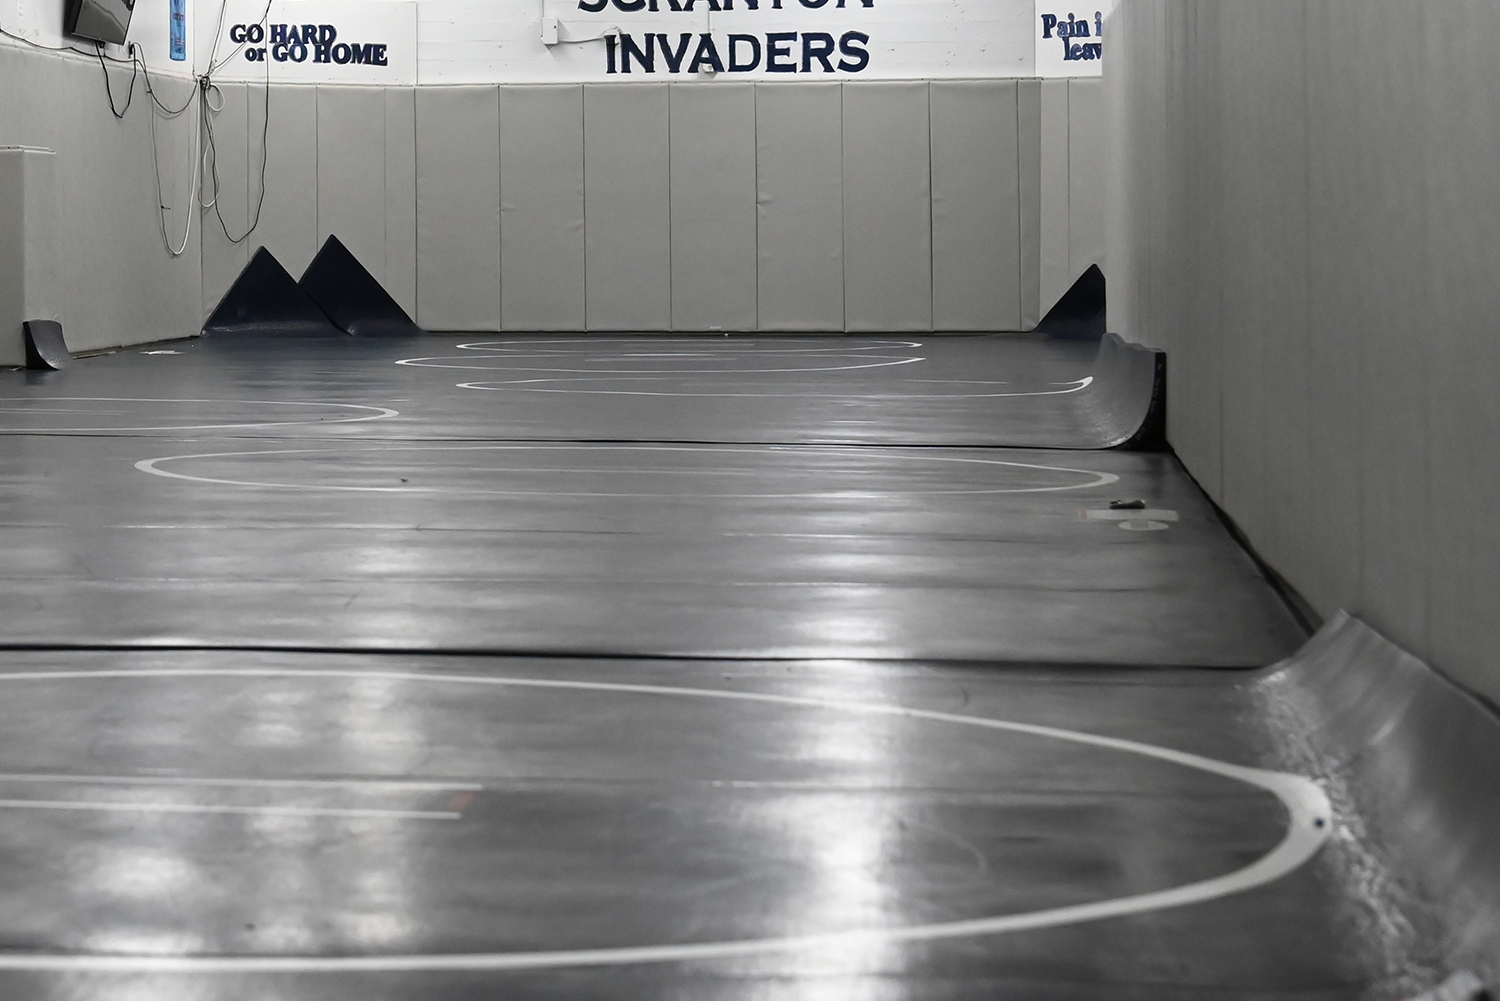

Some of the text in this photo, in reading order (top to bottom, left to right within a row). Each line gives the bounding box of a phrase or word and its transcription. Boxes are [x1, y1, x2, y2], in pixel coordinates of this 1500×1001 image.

[229, 24, 337, 45] GO HARD
[1041, 12, 1090, 38] Pain
[244, 43, 388, 66] or GO HOME
[605, 30, 870, 74] INVADERS
[1062, 37, 1102, 60] leav
